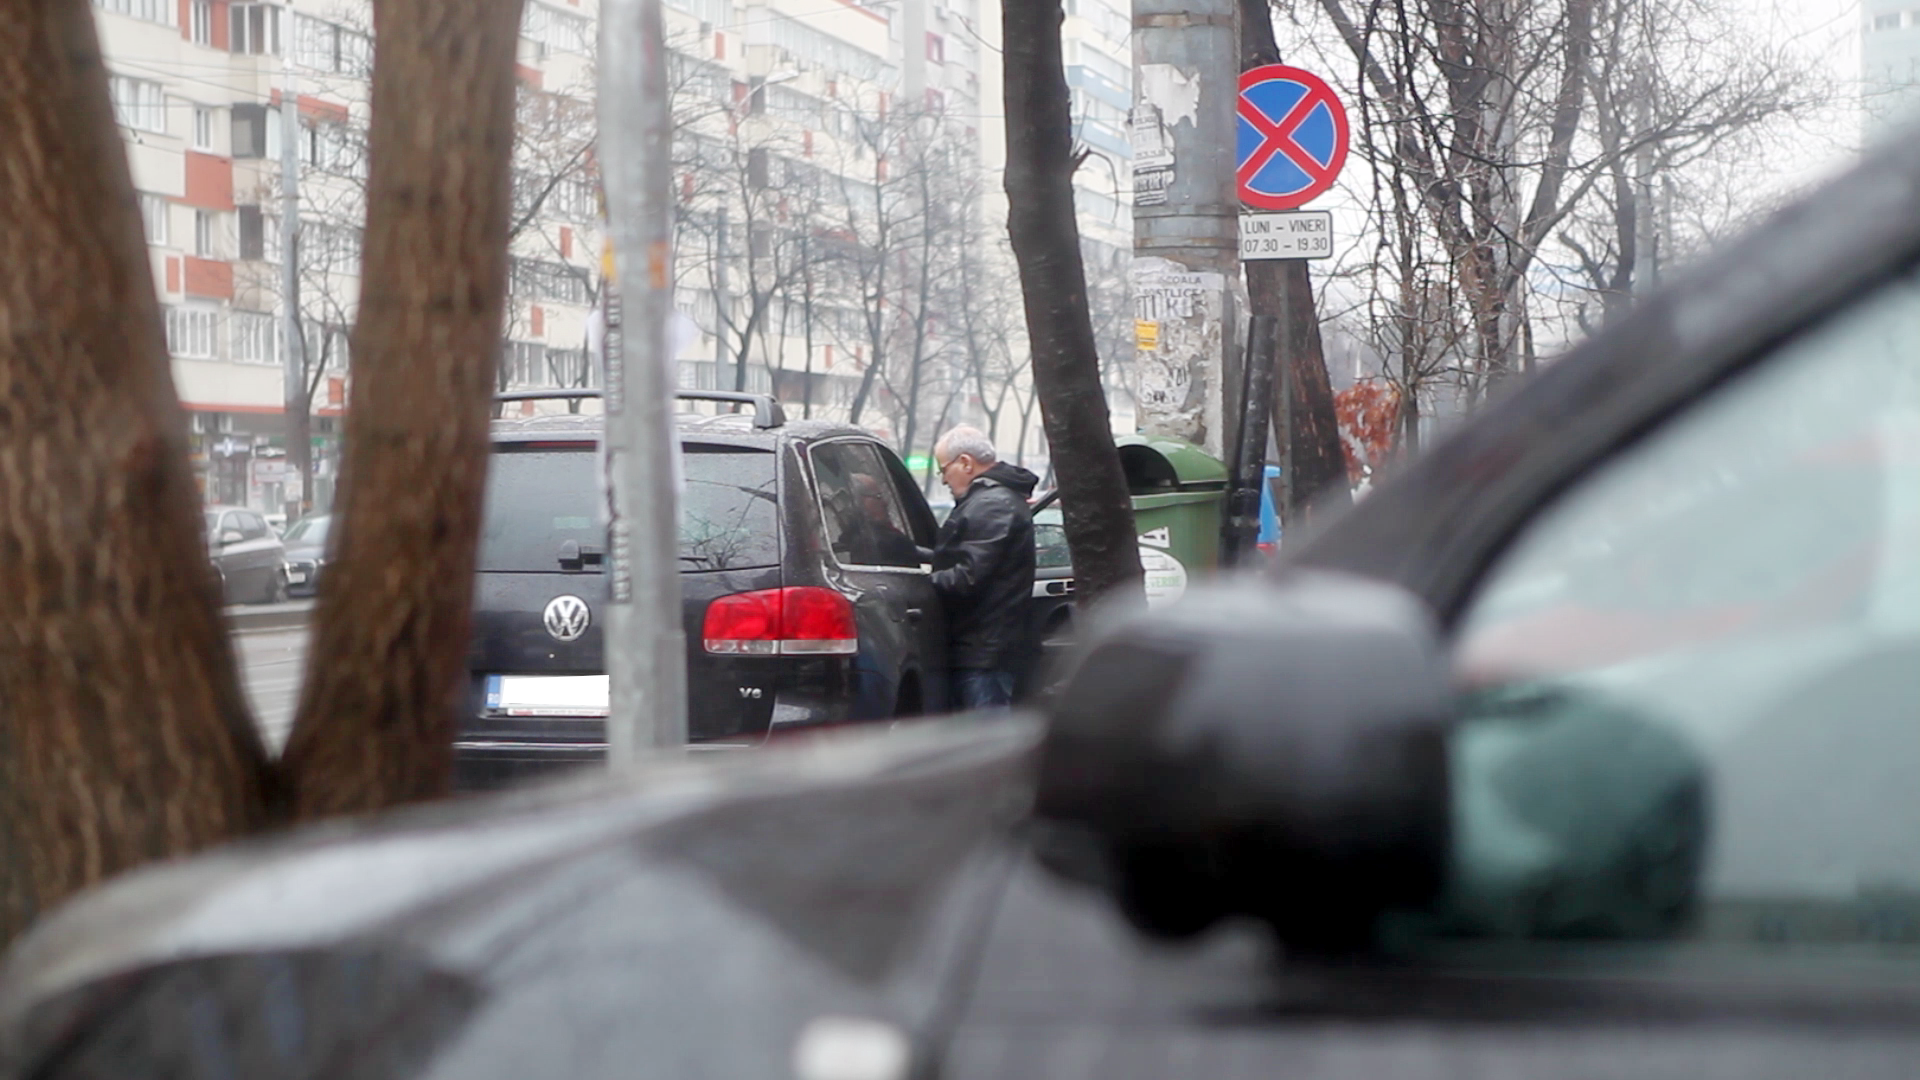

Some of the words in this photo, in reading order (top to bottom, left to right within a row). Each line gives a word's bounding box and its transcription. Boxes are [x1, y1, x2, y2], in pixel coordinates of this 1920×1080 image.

[1244, 221, 1270, 234] LUNI
[1288, 219, 1326, 233] VINERI
[1244, 239, 1278, 253] 07.30
[1297, 237, 1328, 251] 19.30
[739, 687, 762, 699] V6
